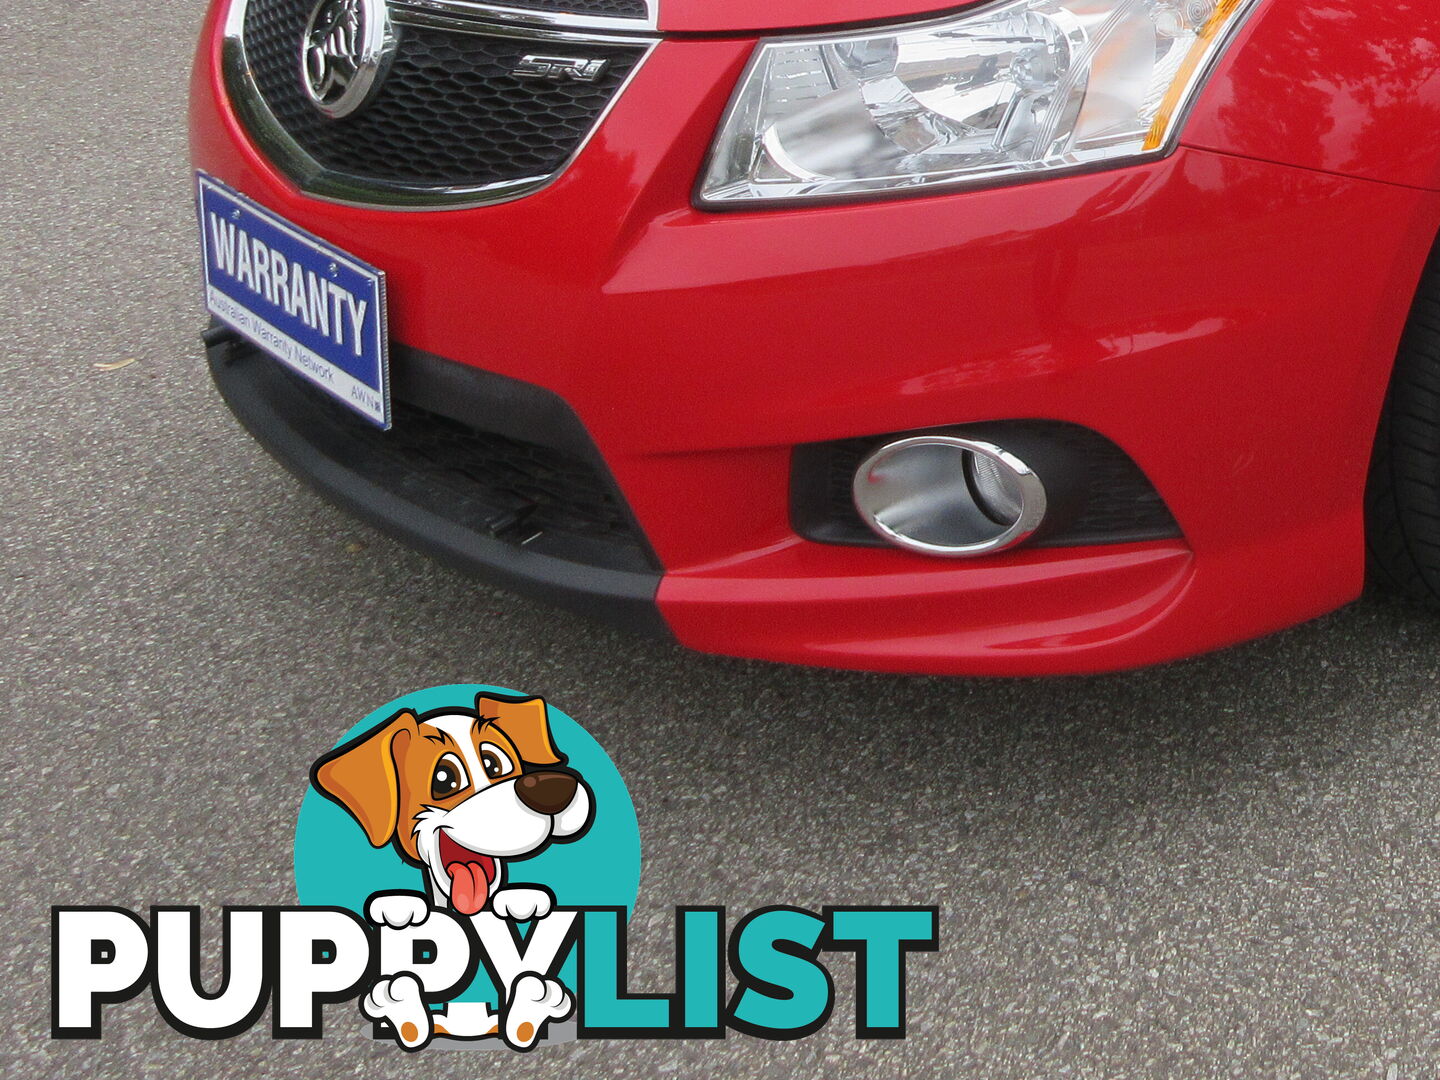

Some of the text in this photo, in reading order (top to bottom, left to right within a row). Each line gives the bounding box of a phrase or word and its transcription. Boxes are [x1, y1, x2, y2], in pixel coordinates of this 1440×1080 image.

[209, 288, 335, 383] Australian Warranty Network
[210, 211, 367, 356] WARRANTY
